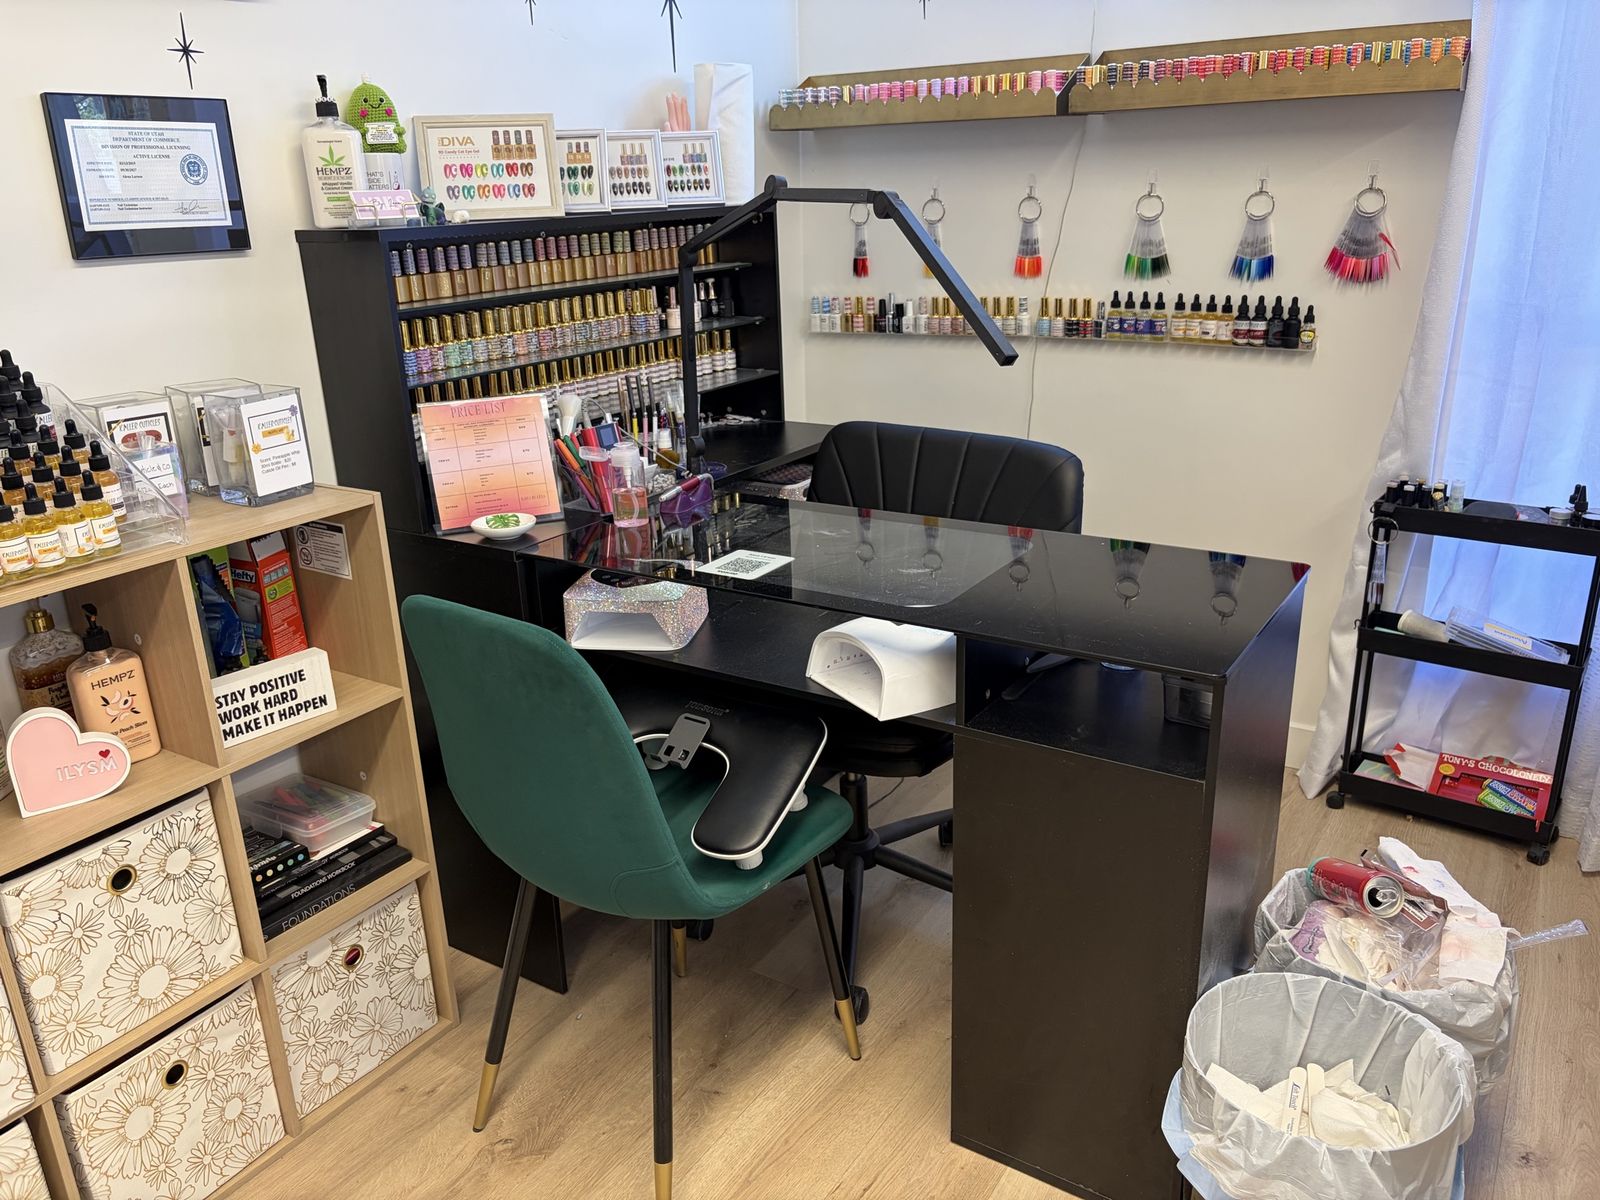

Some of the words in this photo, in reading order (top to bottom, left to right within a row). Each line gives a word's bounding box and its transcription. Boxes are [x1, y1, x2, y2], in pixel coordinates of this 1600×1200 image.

[441, 136, 475, 147] DIVA
[315, 166, 352, 176] HEMPZ
[450, 403, 481, 419] PRICE
[484, 401, 506, 414] LIST
[139, 418, 160, 429] CUTICLES
[230, 568, 255, 583] Hefty
[91, 669, 136, 691] HEMPZ
[215, 688, 246, 709] STAY
[250, 669, 306, 698] POSITIVE
[218, 700, 260, 725] WORK
[263, 688, 298, 710] HARD
[222, 718, 262, 741] MAKE
[264, 712, 276, 727] IT
[278, 694, 328, 722] HAPPEN
[119, 725, 134, 735] Peach
[134, 720, 148, 730] Slices
[56, 757, 118, 782] ILYSM
[1442, 753, 1476, 768] TONY'S
[1478, 761, 1554, 785] CHOCOLONELY
[291, 876, 328, 899] FOUNDATIONS
[326, 861, 356, 880] WORKBOOK
[281, 883, 356, 932] FOUNDATIONS
